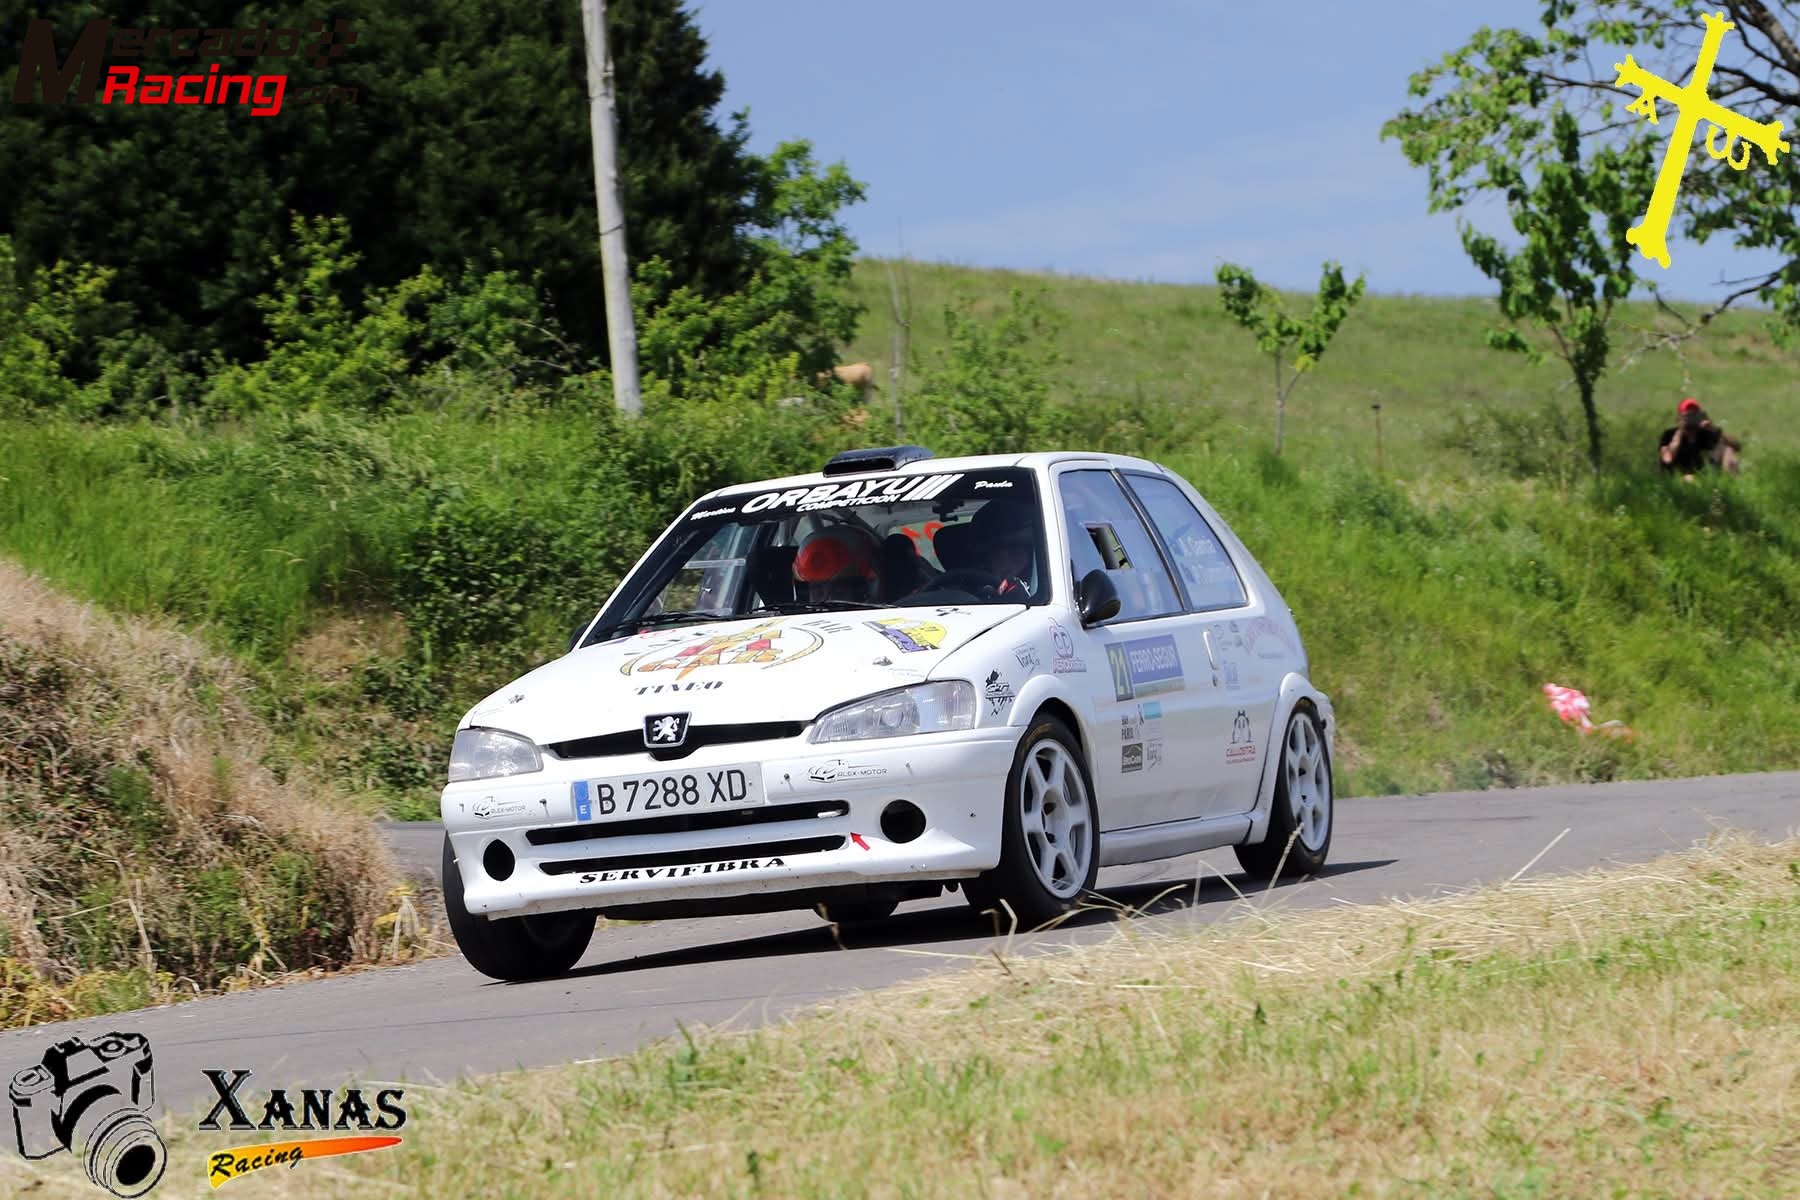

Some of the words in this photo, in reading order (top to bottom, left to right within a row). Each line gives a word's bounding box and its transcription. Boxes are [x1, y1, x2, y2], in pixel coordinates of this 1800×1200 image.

[741, 476, 925, 514] ORBAYU
[796, 494, 899, 512] COMPETICION
[1109, 648, 1131, 695] 21
[597, 783, 616, 815] B
[623, 774, 700, 812] 7288
[707, 769, 747, 803] XD
[579, 805, 587, 815] E
[580, 857, 788, 883] SERVIFIBRA
